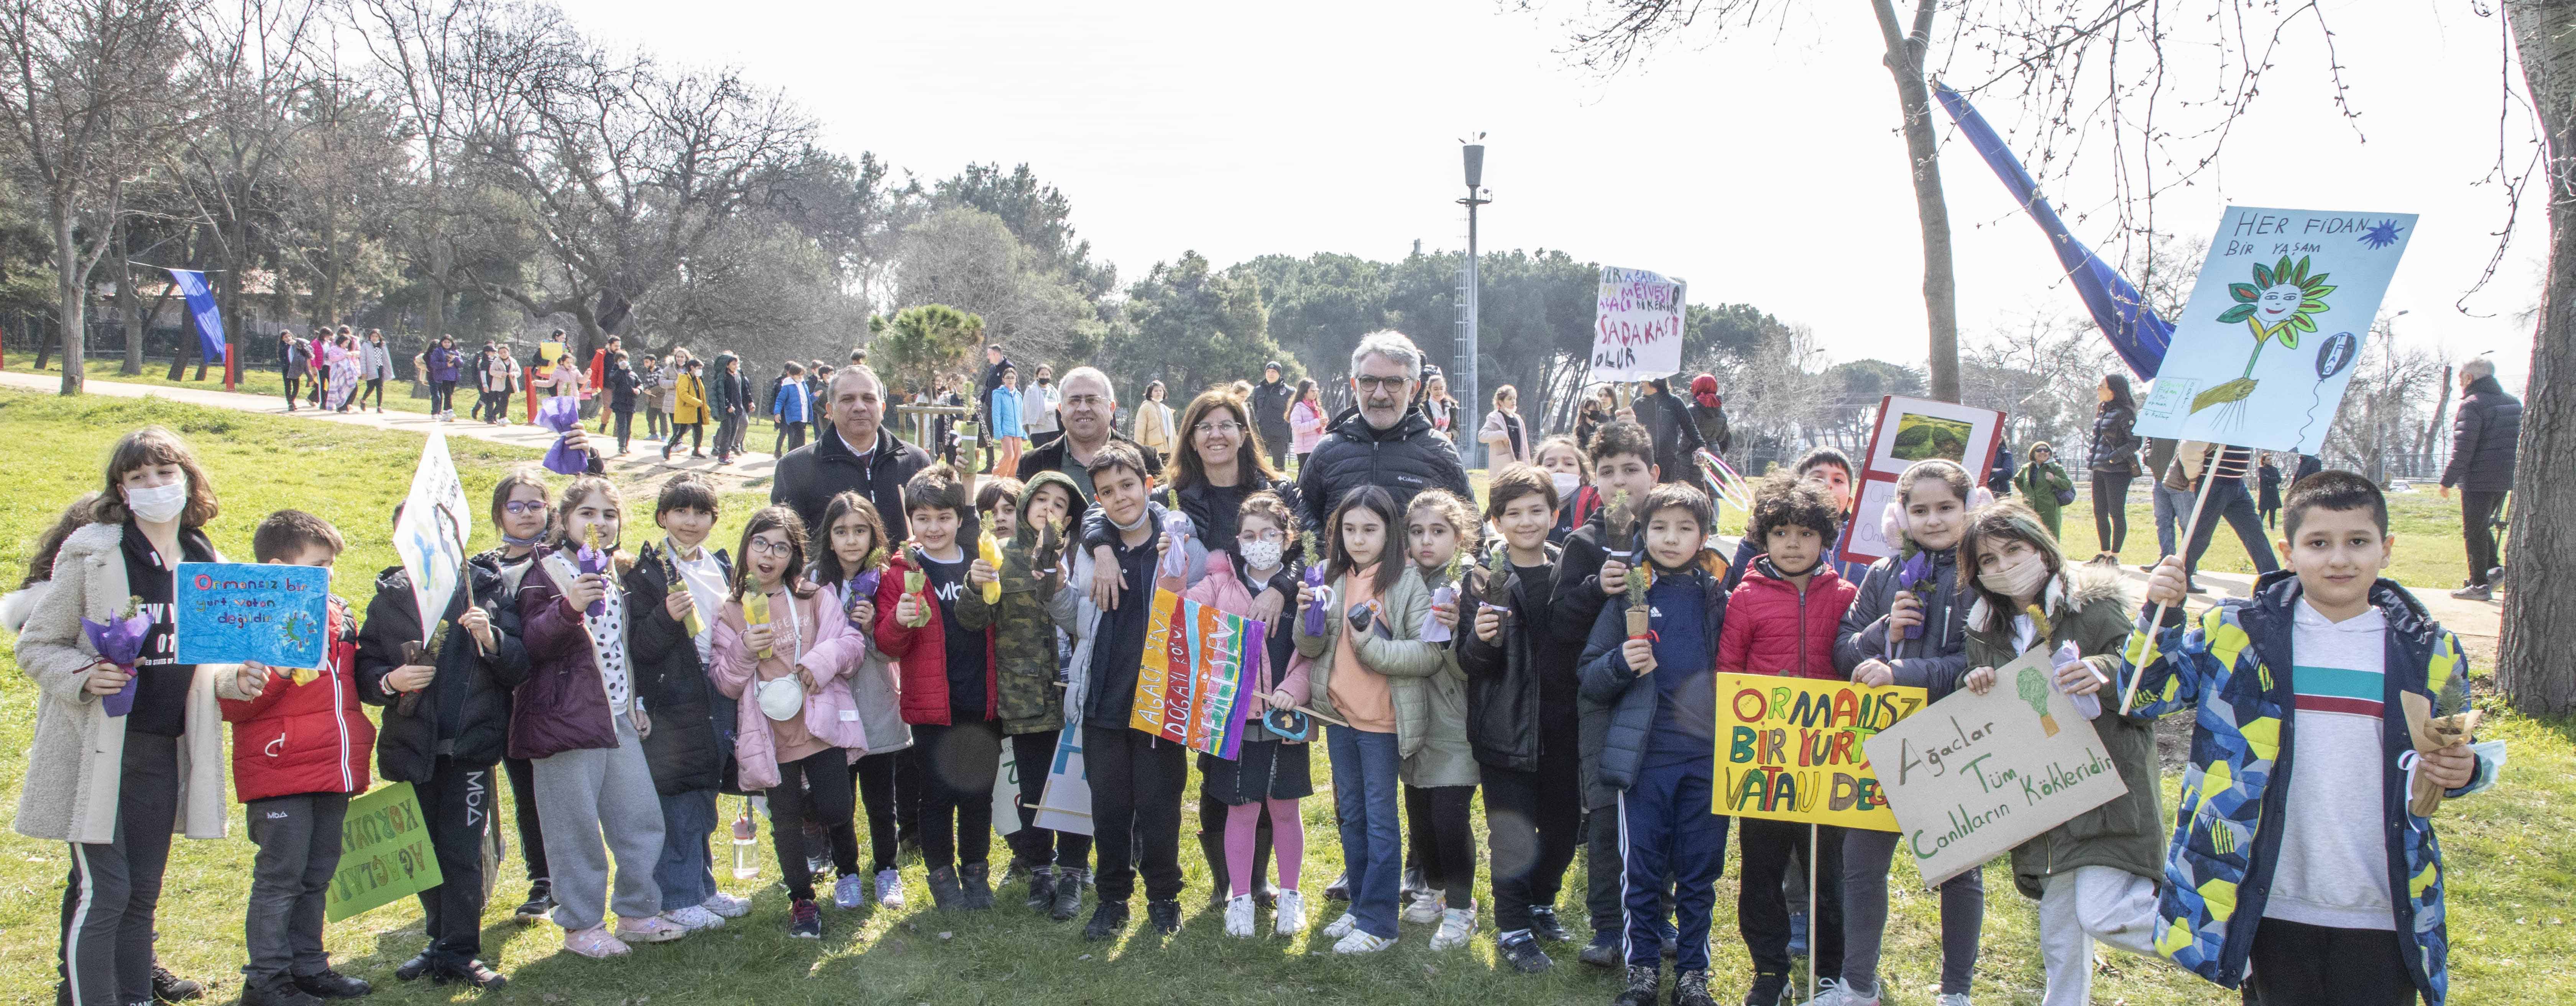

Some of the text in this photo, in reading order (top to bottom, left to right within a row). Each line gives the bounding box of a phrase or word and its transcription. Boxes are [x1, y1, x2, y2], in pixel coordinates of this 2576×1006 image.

[2234, 212, 2370, 236] HER FİDAN
[2224, 240, 2321, 256] BİR YAŞAM
[1595, 347, 1635, 370] OLUR
[195, 574, 307, 591] Ormansız bir
[196, 597, 275, 612] yurt vatan
[1164, 671, 1190, 737] DOĞAYI
[1798, 727, 1878, 766] YURT
[1726, 766, 1821, 812] VATAN
[1959, 753, 2017, 793] Tüm
[1912, 747, 2111, 859] Canlıların Kökleridir
[341, 798, 419, 855] KORUYA
